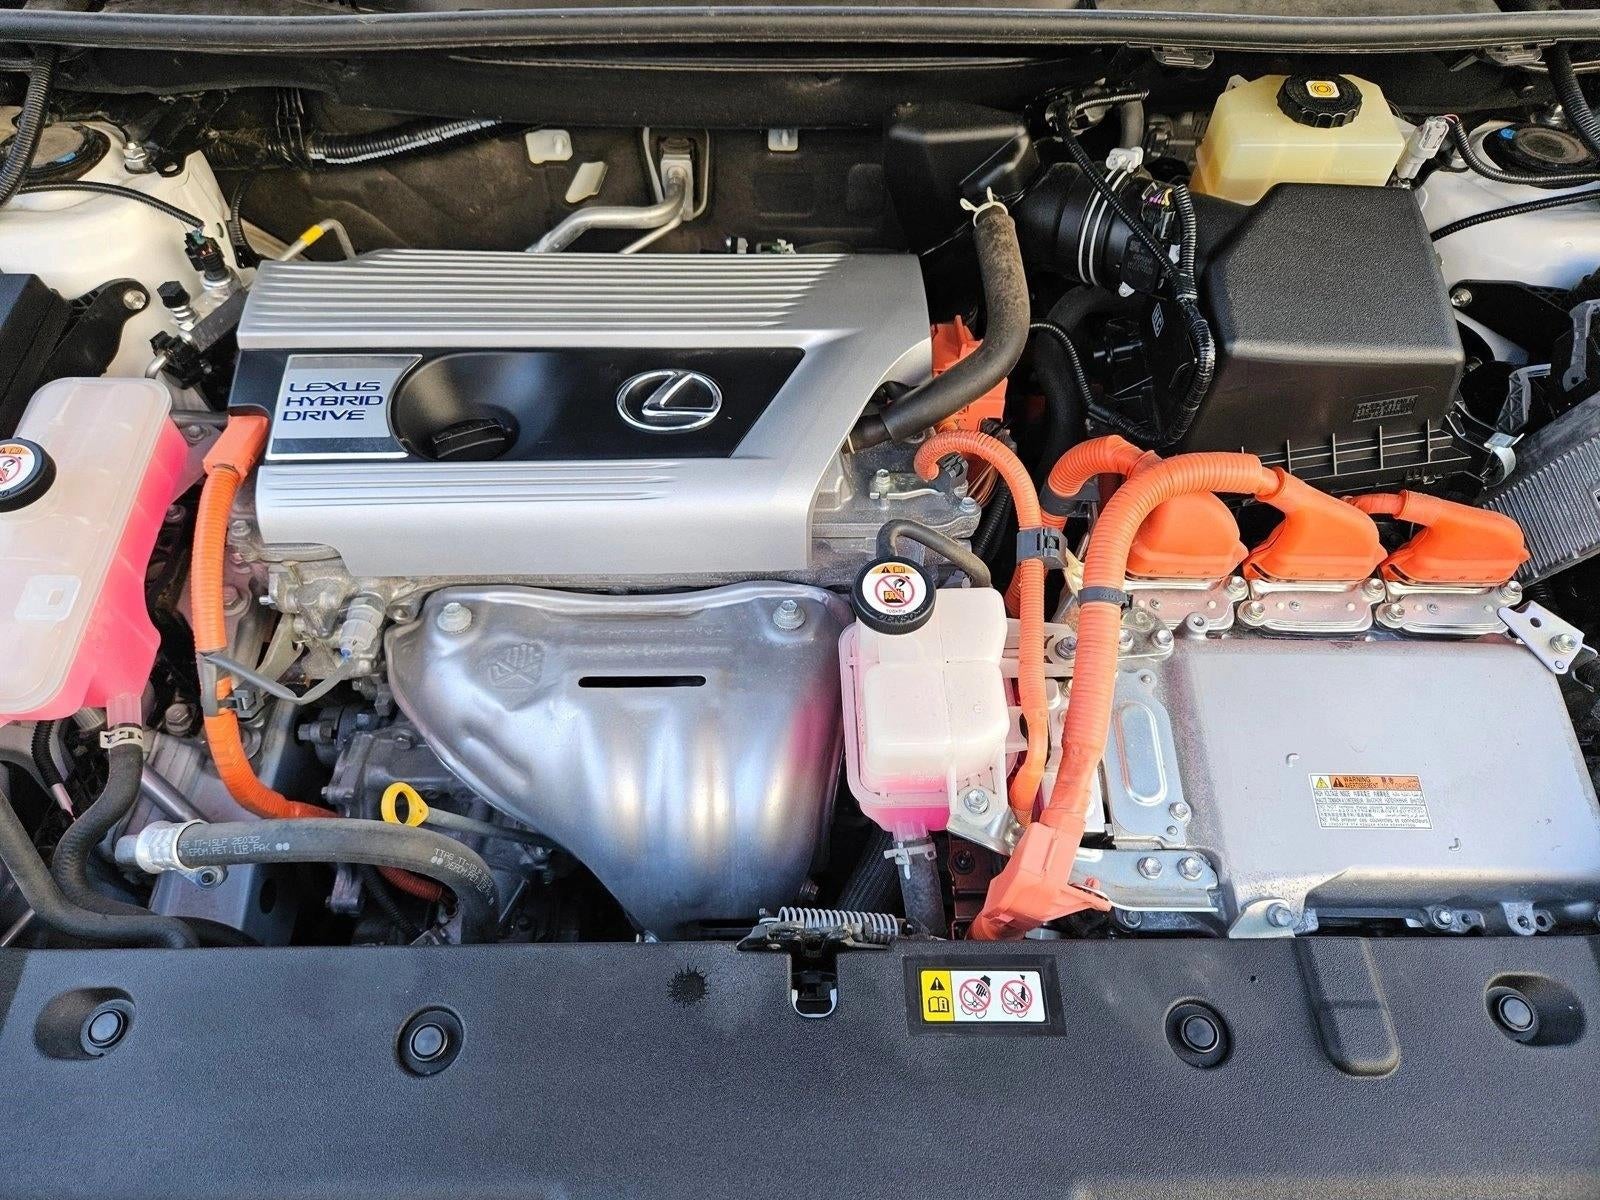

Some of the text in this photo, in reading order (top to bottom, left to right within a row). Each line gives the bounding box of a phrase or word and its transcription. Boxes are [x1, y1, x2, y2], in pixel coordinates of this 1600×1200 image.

[289, 381, 381, 392] LEXUS
[285, 395, 384, 406] HYBRID
[282, 410, 366, 421] DRIVE
